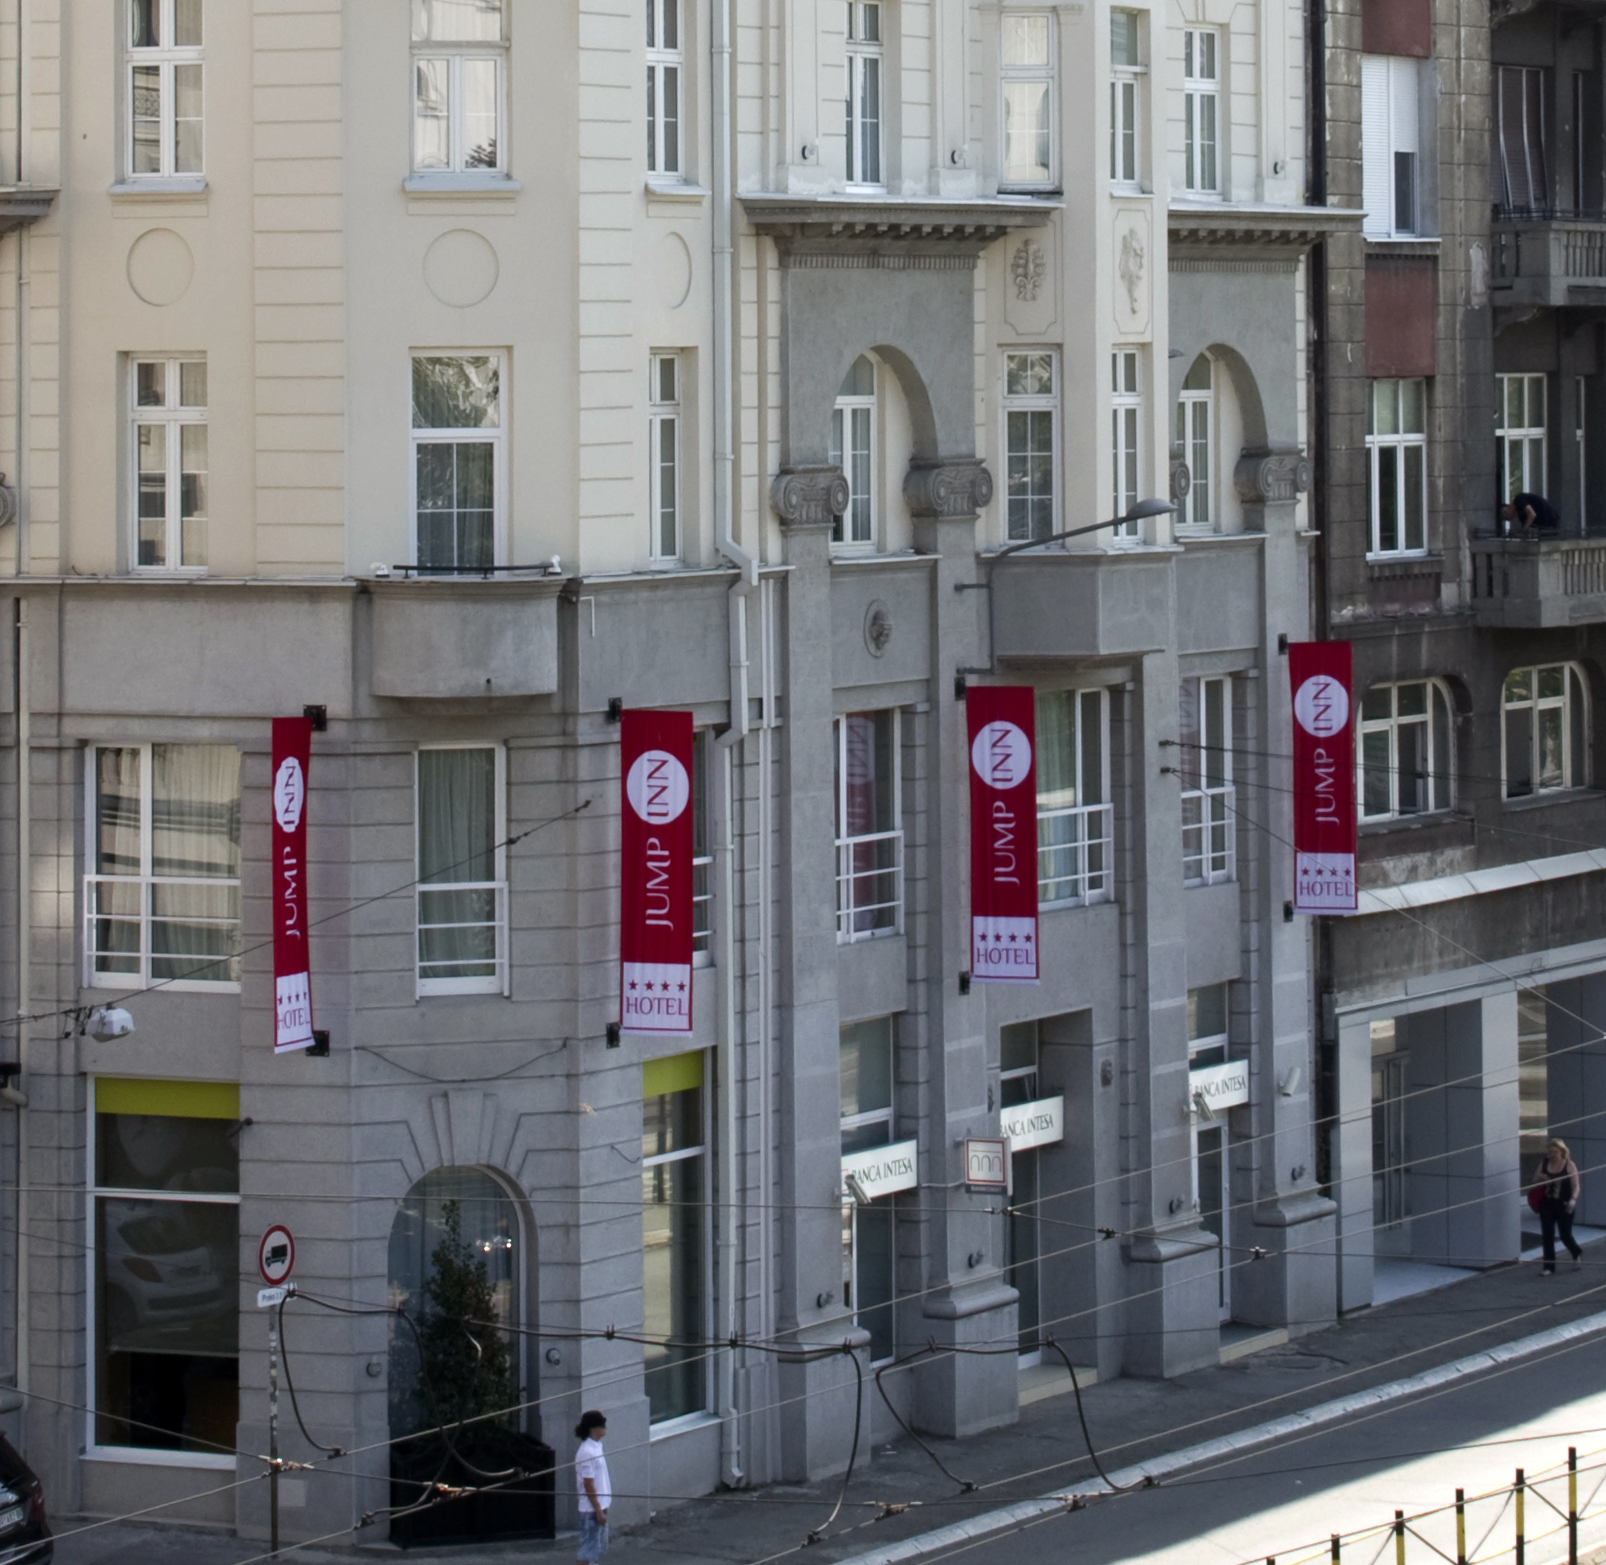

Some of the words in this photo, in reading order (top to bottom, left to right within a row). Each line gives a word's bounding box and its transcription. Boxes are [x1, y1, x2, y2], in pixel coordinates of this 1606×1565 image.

[1311, 682, 1333, 731] INN
[990, 728, 1013, 783] INN
[283, 766, 297, 825] INN
[646, 758, 670, 818] INN
[1314, 748, 1340, 825] JUMP
[993, 801, 1021, 885] JUMP
[283, 845, 300, 938] JUMP
[645, 837, 674, 931] JUMP
[1299, 880, 1354, 897] HOTEL
[976, 947, 1035, 966] HOTEL
[277, 1008, 311, 1032] HOTEL
[626, 996, 688, 1016] HOTEL
[1221, 1075, 1247, 1094] INTESA
[1026, 1113, 1054, 1133] INTESA
[883, 1157, 913, 1179] INTESA
